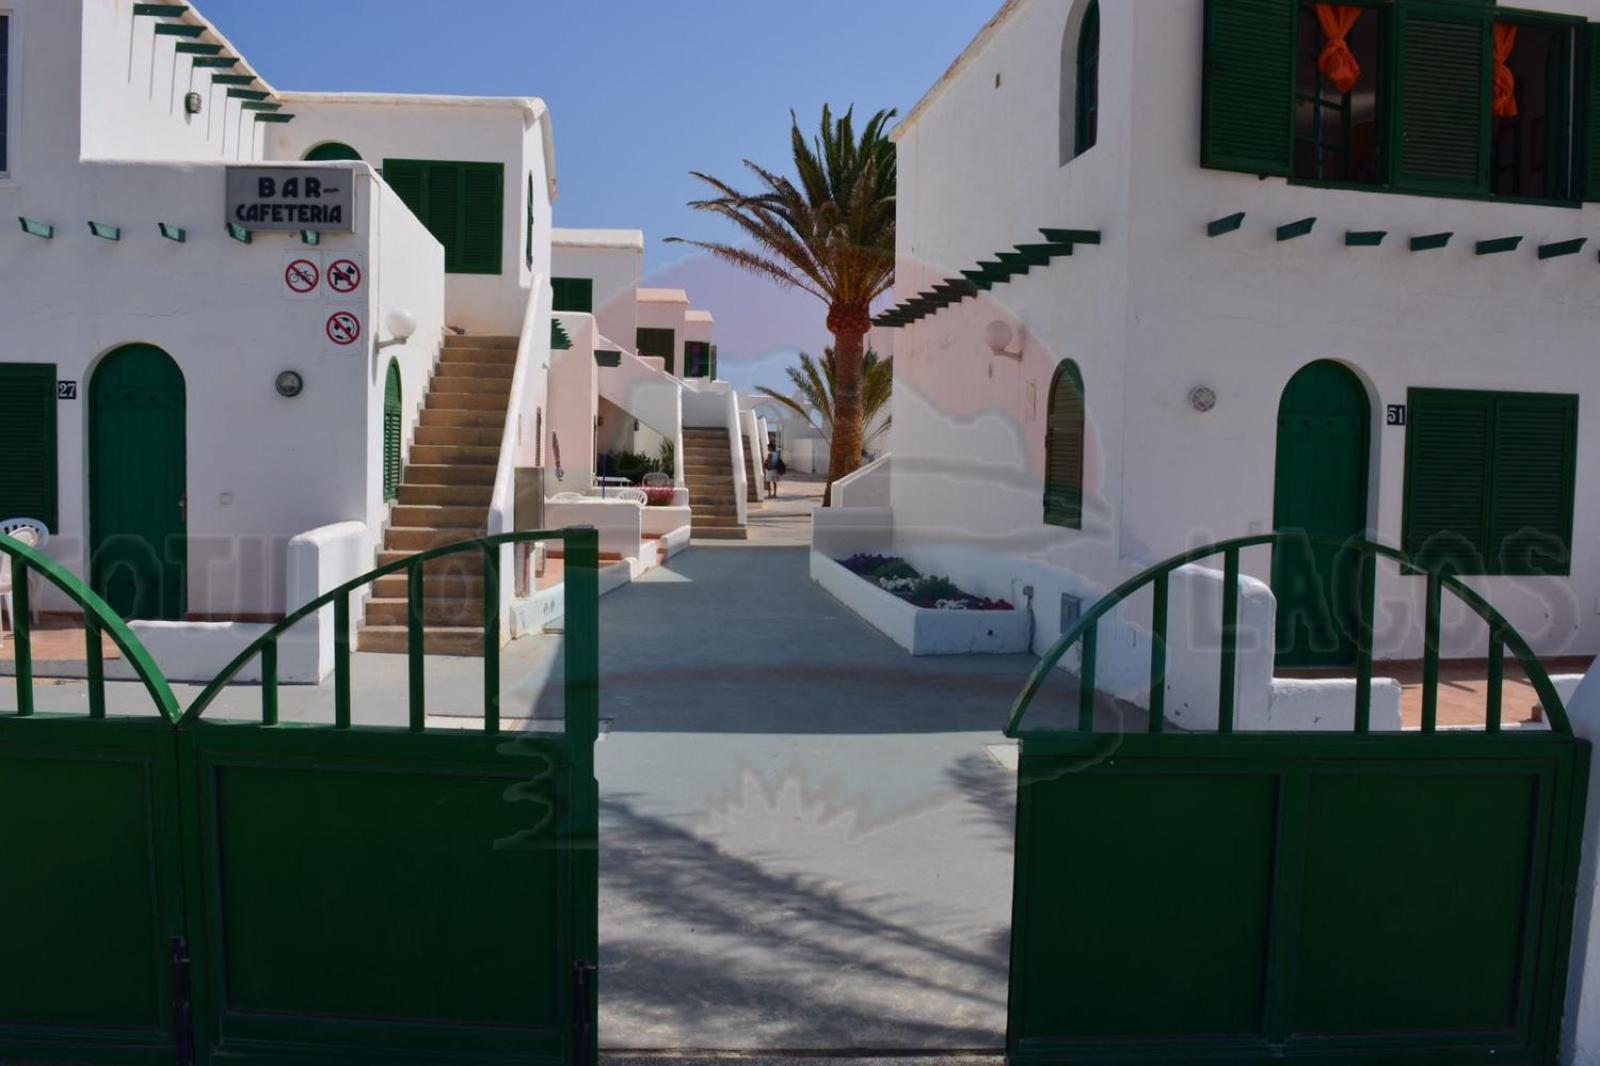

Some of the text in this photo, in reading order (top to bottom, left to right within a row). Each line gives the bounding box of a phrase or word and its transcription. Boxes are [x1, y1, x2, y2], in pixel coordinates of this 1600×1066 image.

[235, 203, 342, 224] CAFETERIA
[59, 382, 76, 398] 27
[1387, 406, 1404, 424] 51
